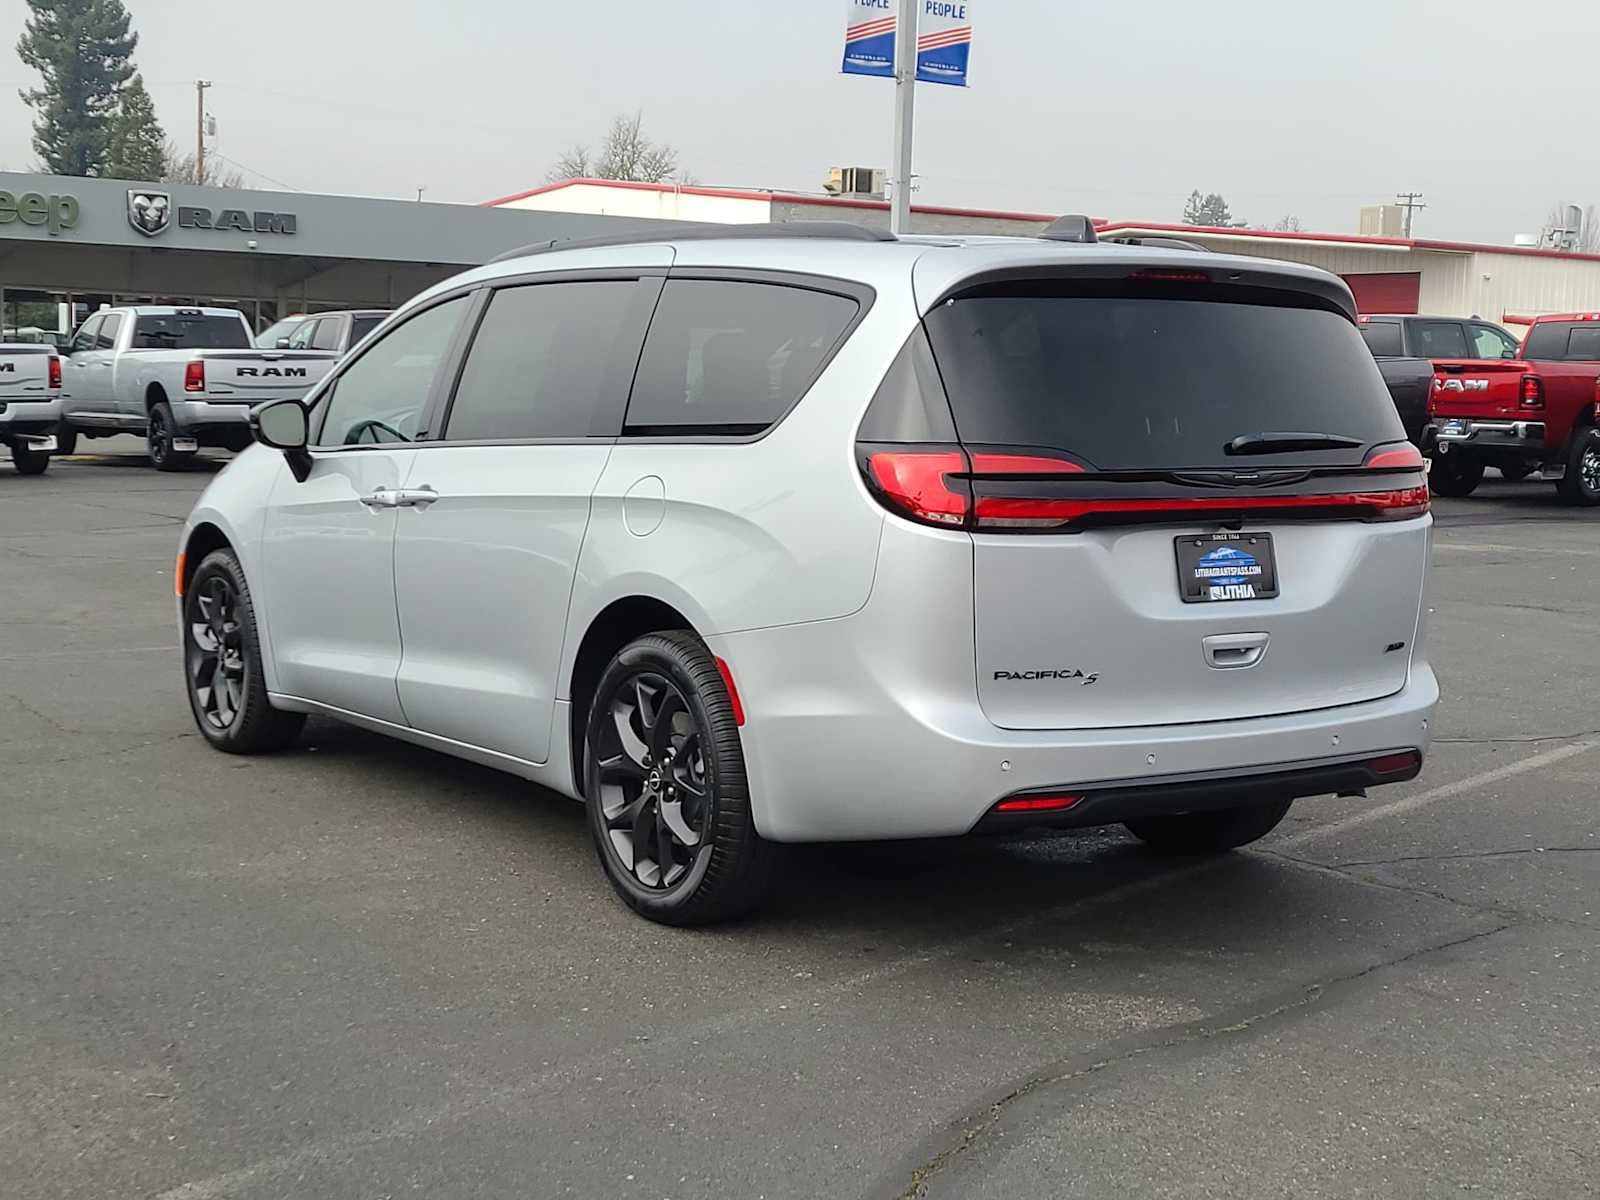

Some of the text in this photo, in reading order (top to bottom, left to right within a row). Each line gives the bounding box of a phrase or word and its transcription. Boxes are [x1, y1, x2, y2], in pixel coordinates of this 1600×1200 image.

[925, 1, 966, 18] PEOPLE
[178, 205, 297, 234] RAM
[236, 367, 307, 377] RAM
[1221, 584, 1256, 599] LITHIA
[993, 669, 1084, 681] PACIFICA
